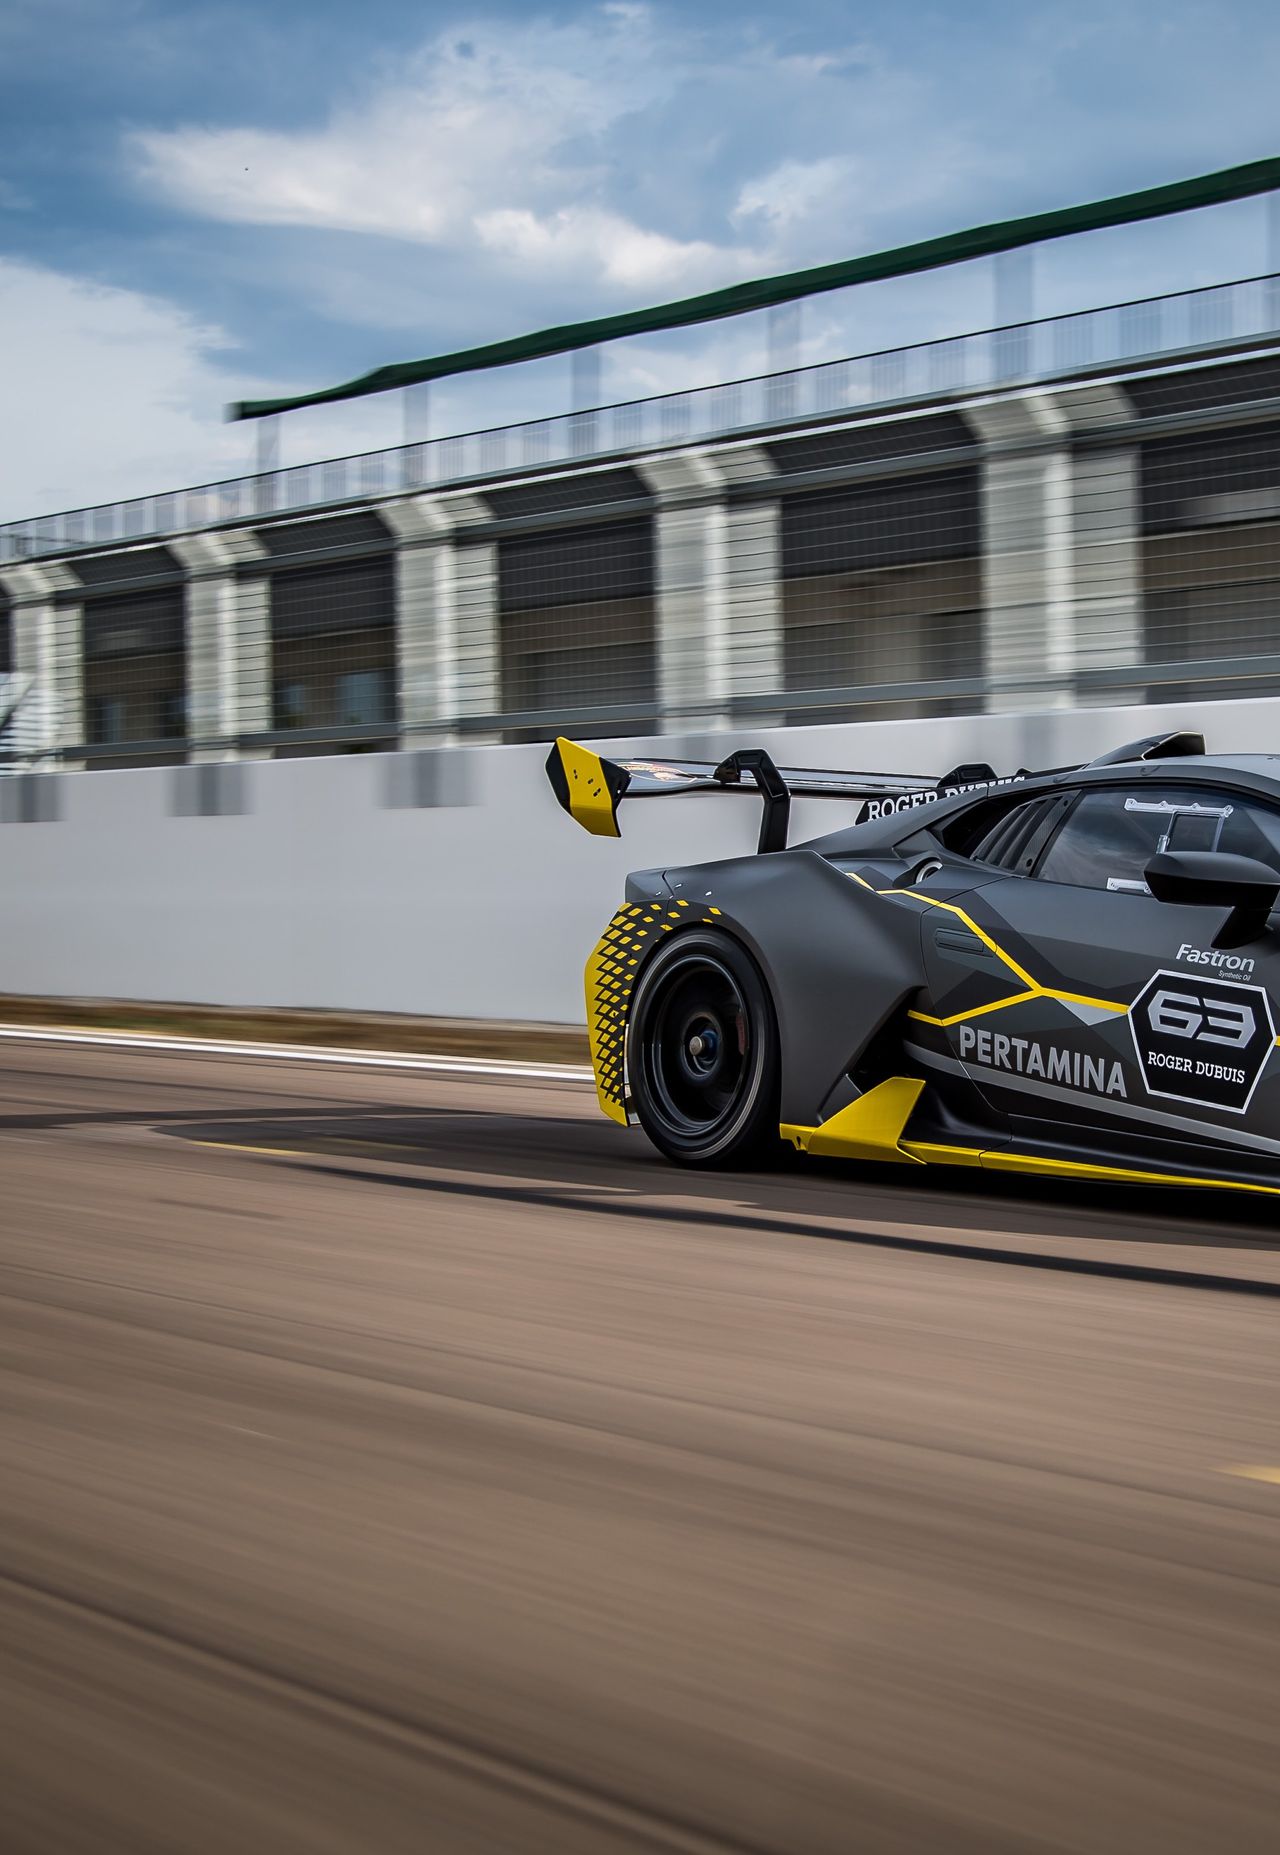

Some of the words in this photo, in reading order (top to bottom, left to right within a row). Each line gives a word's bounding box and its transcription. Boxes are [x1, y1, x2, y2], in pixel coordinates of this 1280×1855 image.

[1175, 943, 1255, 972] Fastron
[1218, 970, 1242, 980] Synthetic
[1147, 990, 1256, 1049] 63
[959, 1025, 1128, 1098] PERTAMINA
[1147, 1051, 1193, 1073] ROGER
[1195, 1061, 1246, 1084] DUBUIS
